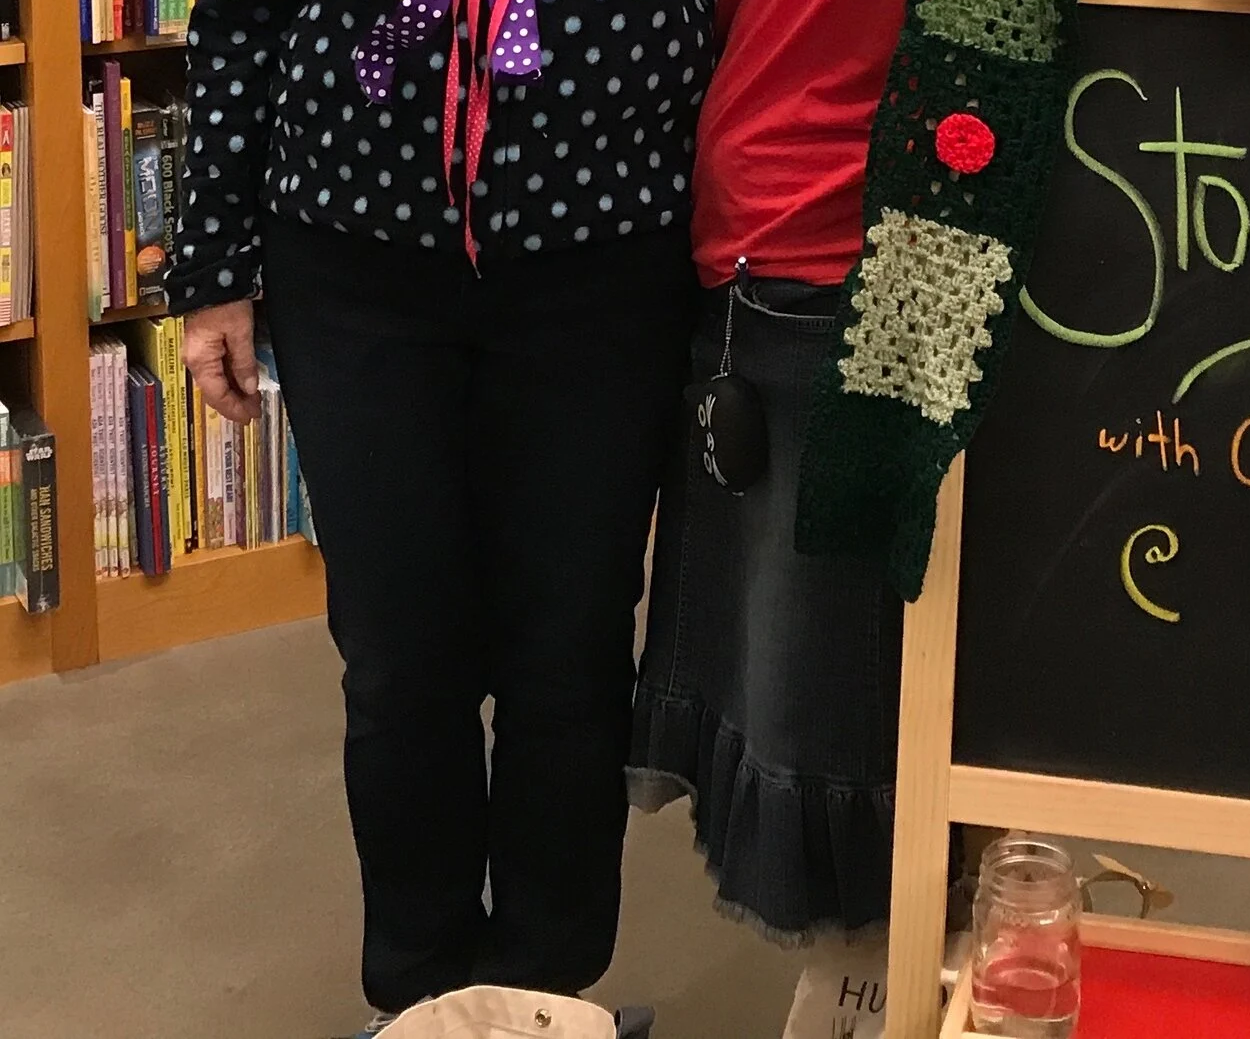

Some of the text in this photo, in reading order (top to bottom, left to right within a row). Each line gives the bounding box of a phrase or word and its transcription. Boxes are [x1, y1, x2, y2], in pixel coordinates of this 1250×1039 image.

[161, 155, 176, 252] 600 Black Spots
[151, 445, 159, 495] JOURNEY
[1099, 410, 1200, 477] with
